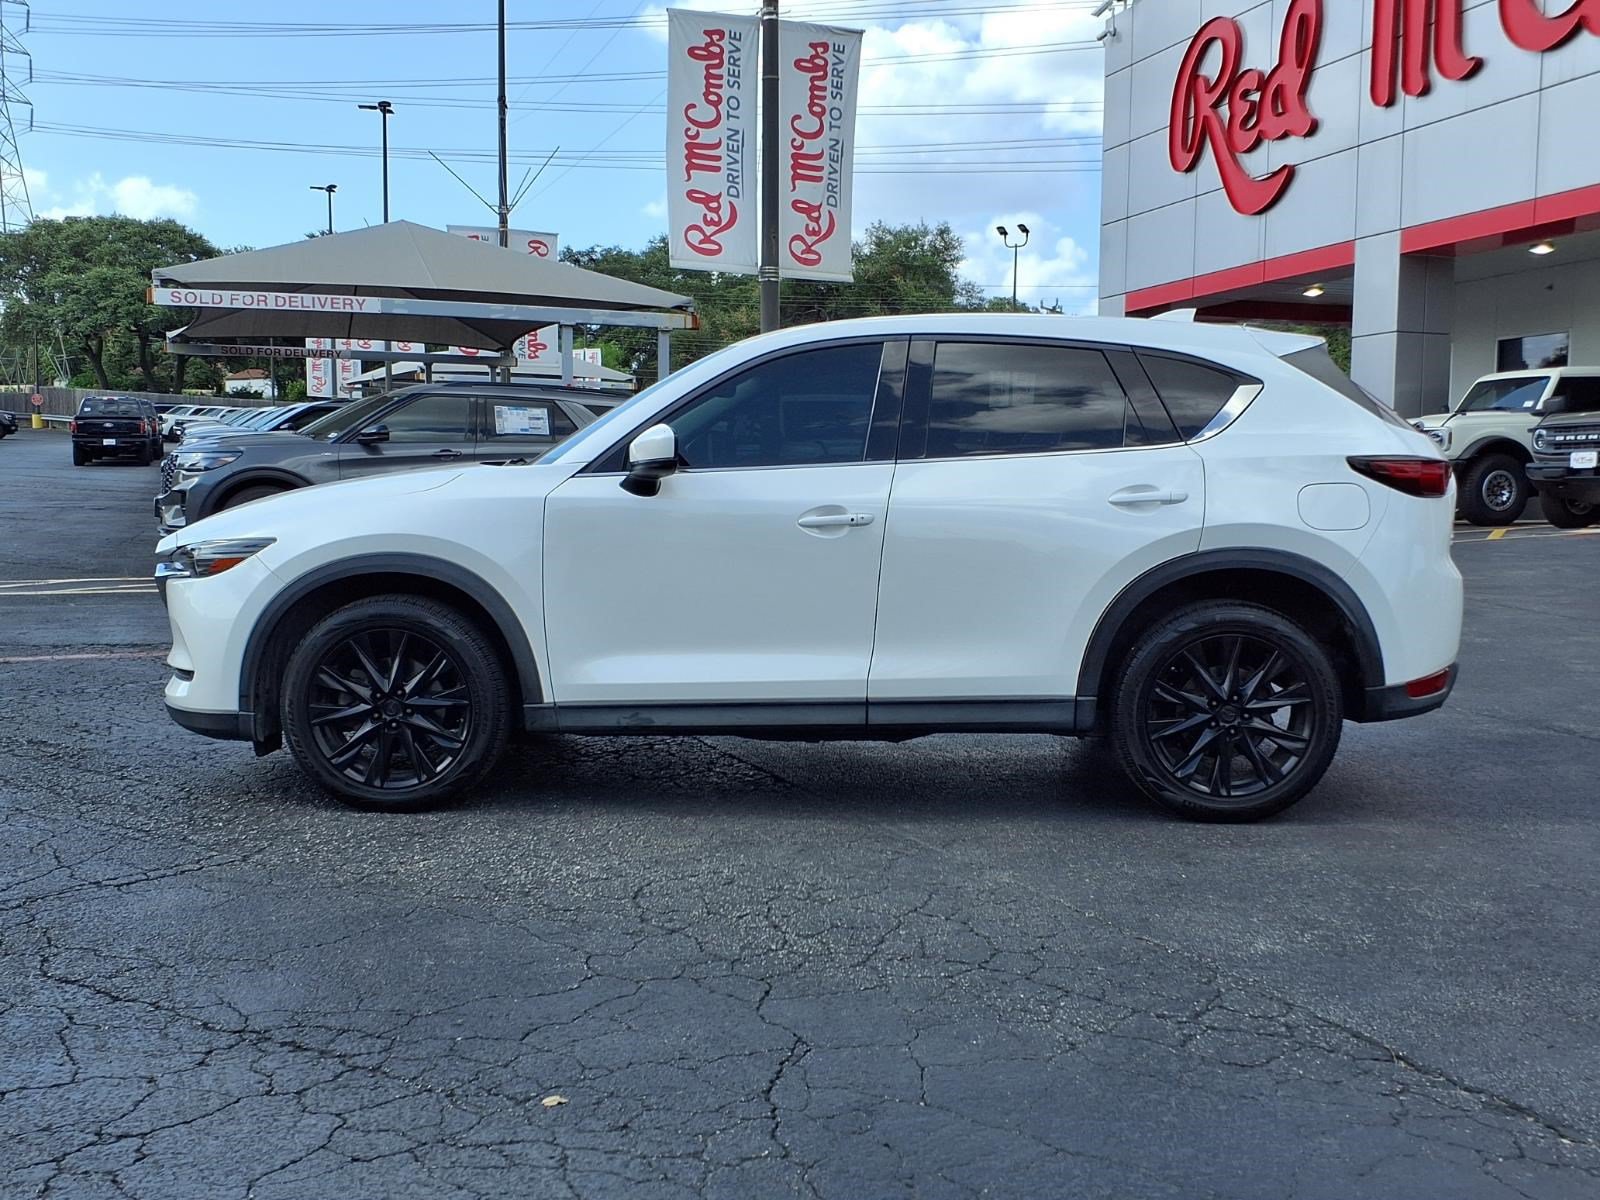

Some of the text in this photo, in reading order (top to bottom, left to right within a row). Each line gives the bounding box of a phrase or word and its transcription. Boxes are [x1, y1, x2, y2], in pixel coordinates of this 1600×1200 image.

[684, 28, 738, 257] Red McCombs
[726, 29, 742, 199] DRIVEN TO SERVE
[788, 40, 836, 267] Red McCombs
[826, 43, 845, 208] DRIVEN TO SERVE
[1168, 0, 1323, 216] Red
[170, 290, 366, 311] SOLD FOR DELIVERY
[220, 345, 343, 358] SOLD FOR DELIVERY
